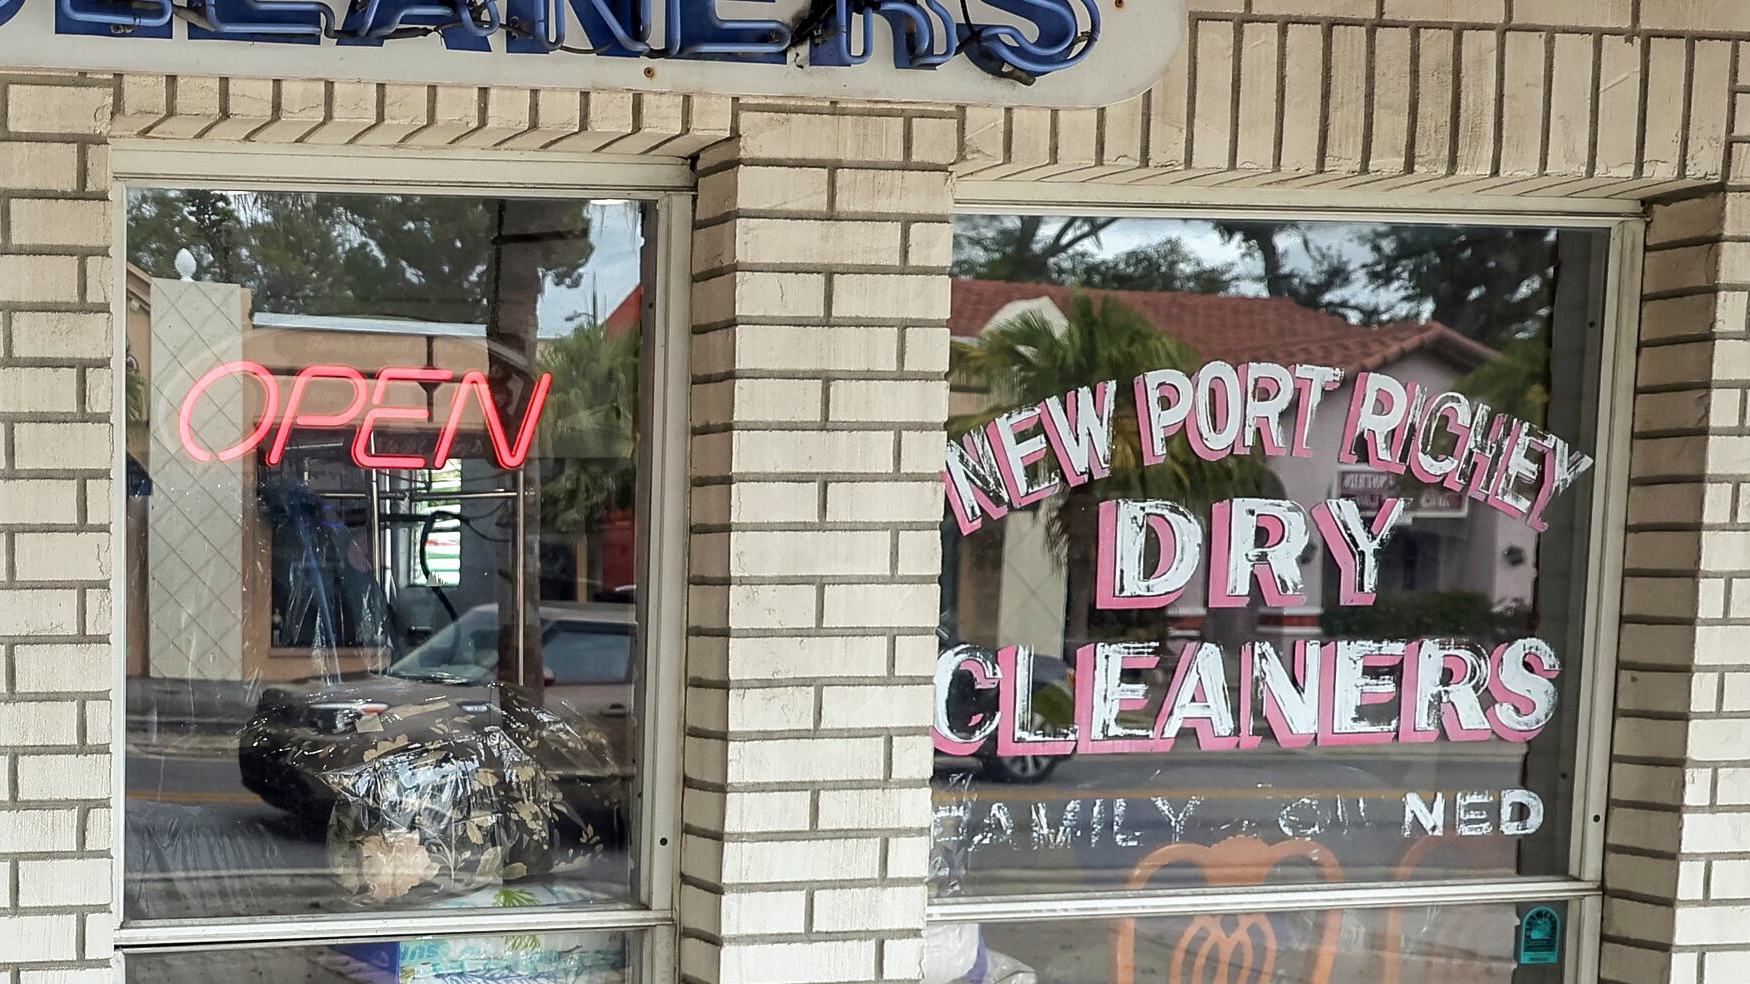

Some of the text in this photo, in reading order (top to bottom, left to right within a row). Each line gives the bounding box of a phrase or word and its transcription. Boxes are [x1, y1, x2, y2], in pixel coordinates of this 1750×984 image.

[177, 360, 553, 471] OPEN
[944, 360, 1595, 536] NEW PORT RICHEY
[1096, 498, 1406, 609] DRY
[930, 637, 1563, 756] CLEANERS
